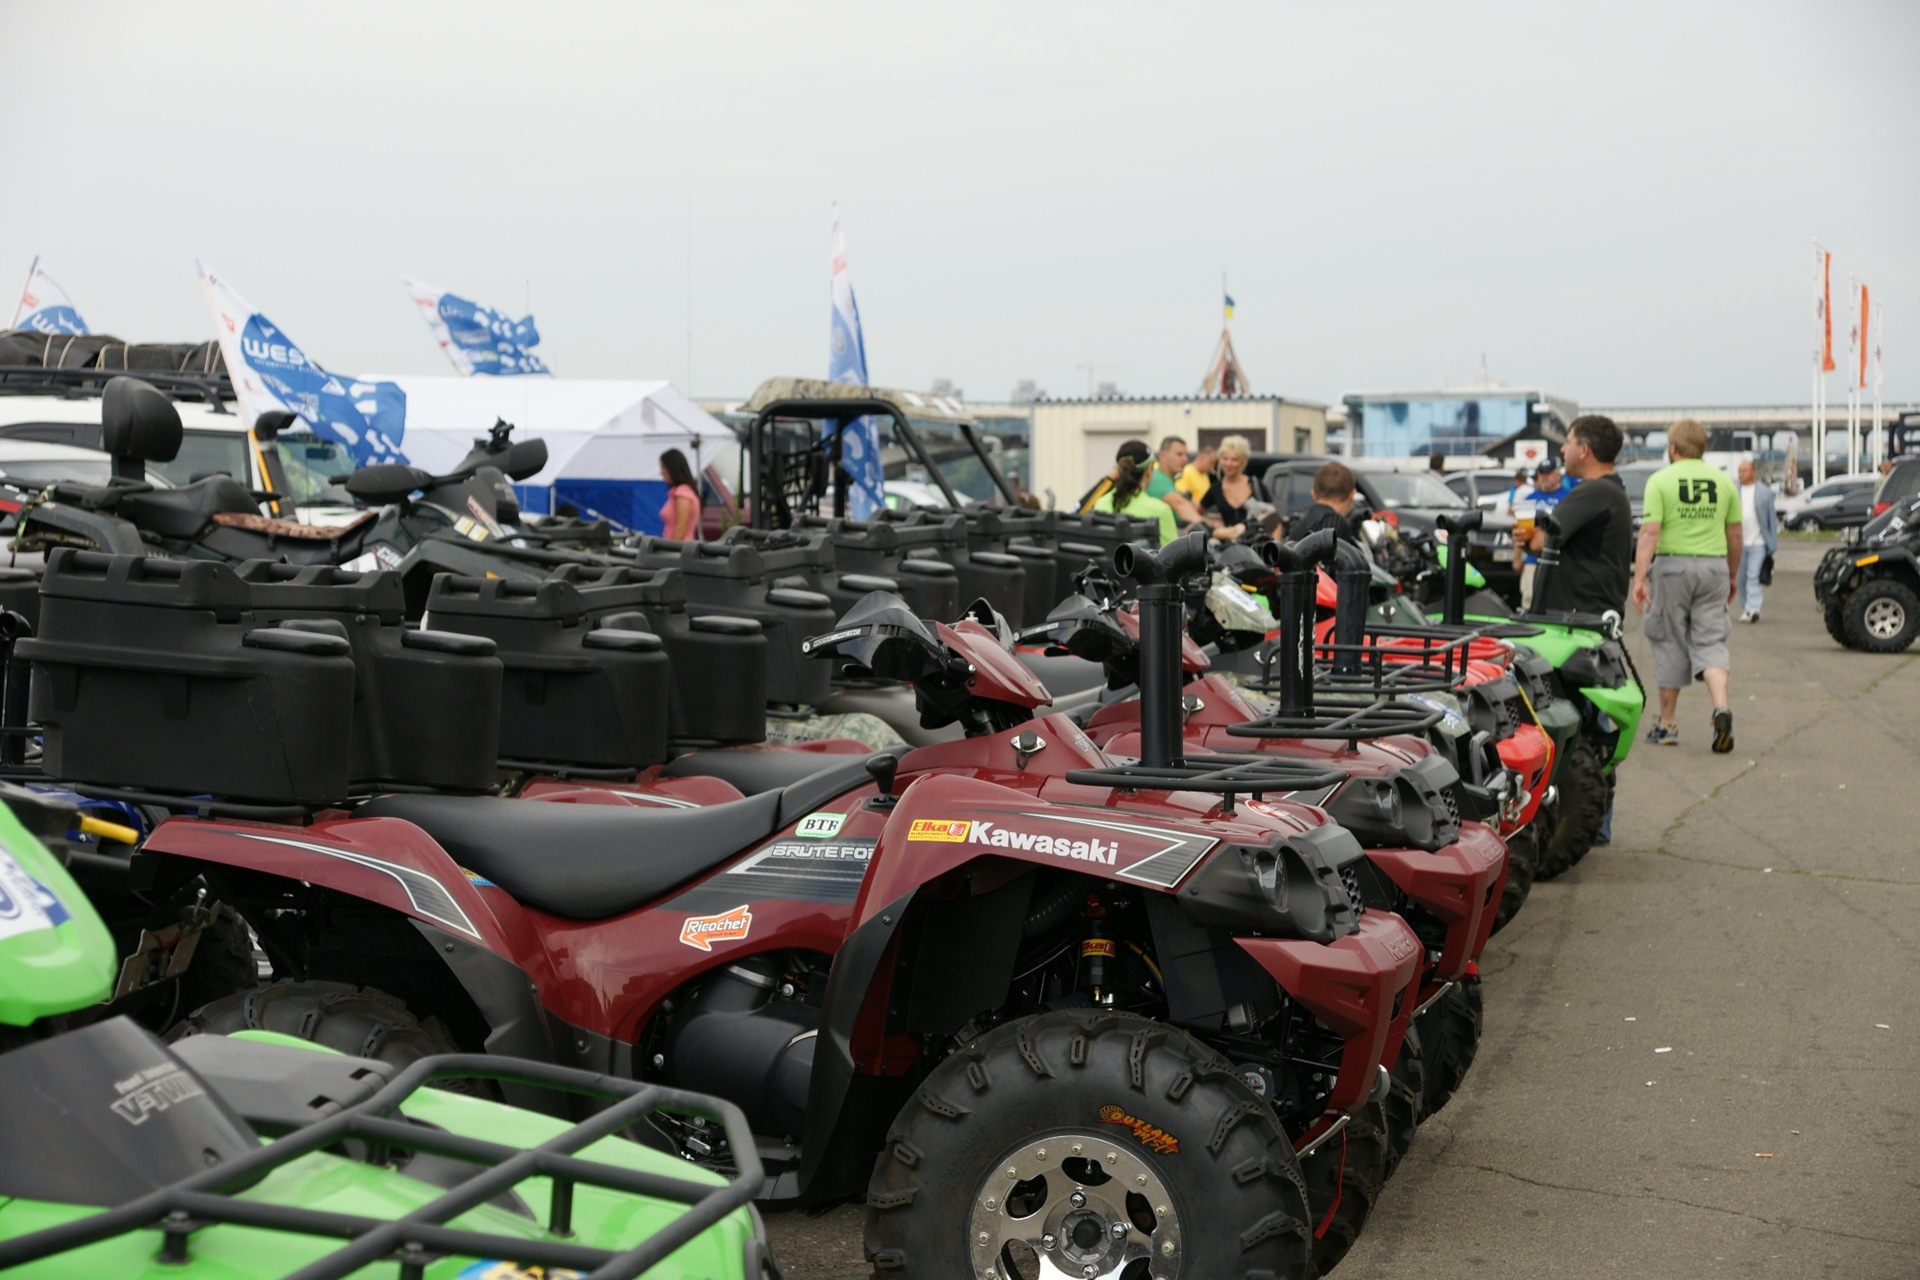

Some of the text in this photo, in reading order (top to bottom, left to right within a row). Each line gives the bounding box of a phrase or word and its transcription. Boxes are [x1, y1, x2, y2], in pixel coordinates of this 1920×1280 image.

[1678, 479, 1718, 505] UR
[912, 821, 949, 832] Elka
[772, 845, 839, 860] BRUTE
[968, 820, 1119, 866] Kawasaki
[686, 916, 747, 934] Ricochet
[1109, 1111, 1179, 1145] OUTLAW
